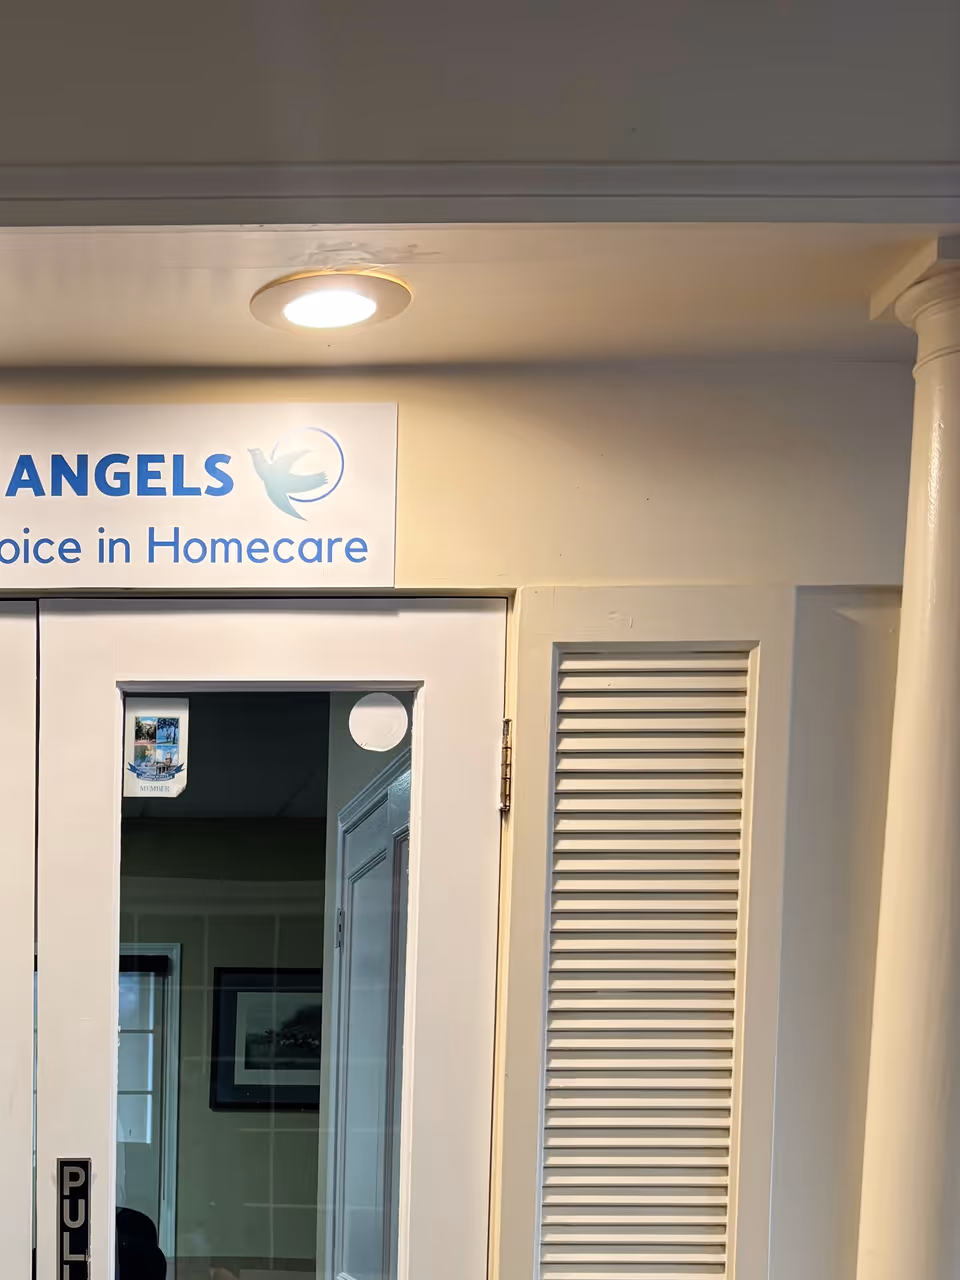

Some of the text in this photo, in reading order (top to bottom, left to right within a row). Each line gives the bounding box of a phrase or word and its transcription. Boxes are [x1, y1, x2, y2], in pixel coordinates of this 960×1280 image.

[4, 453, 235, 498] ANGELS
[98, 526, 131, 564] in
[147, 526, 369, 565] Homecare
